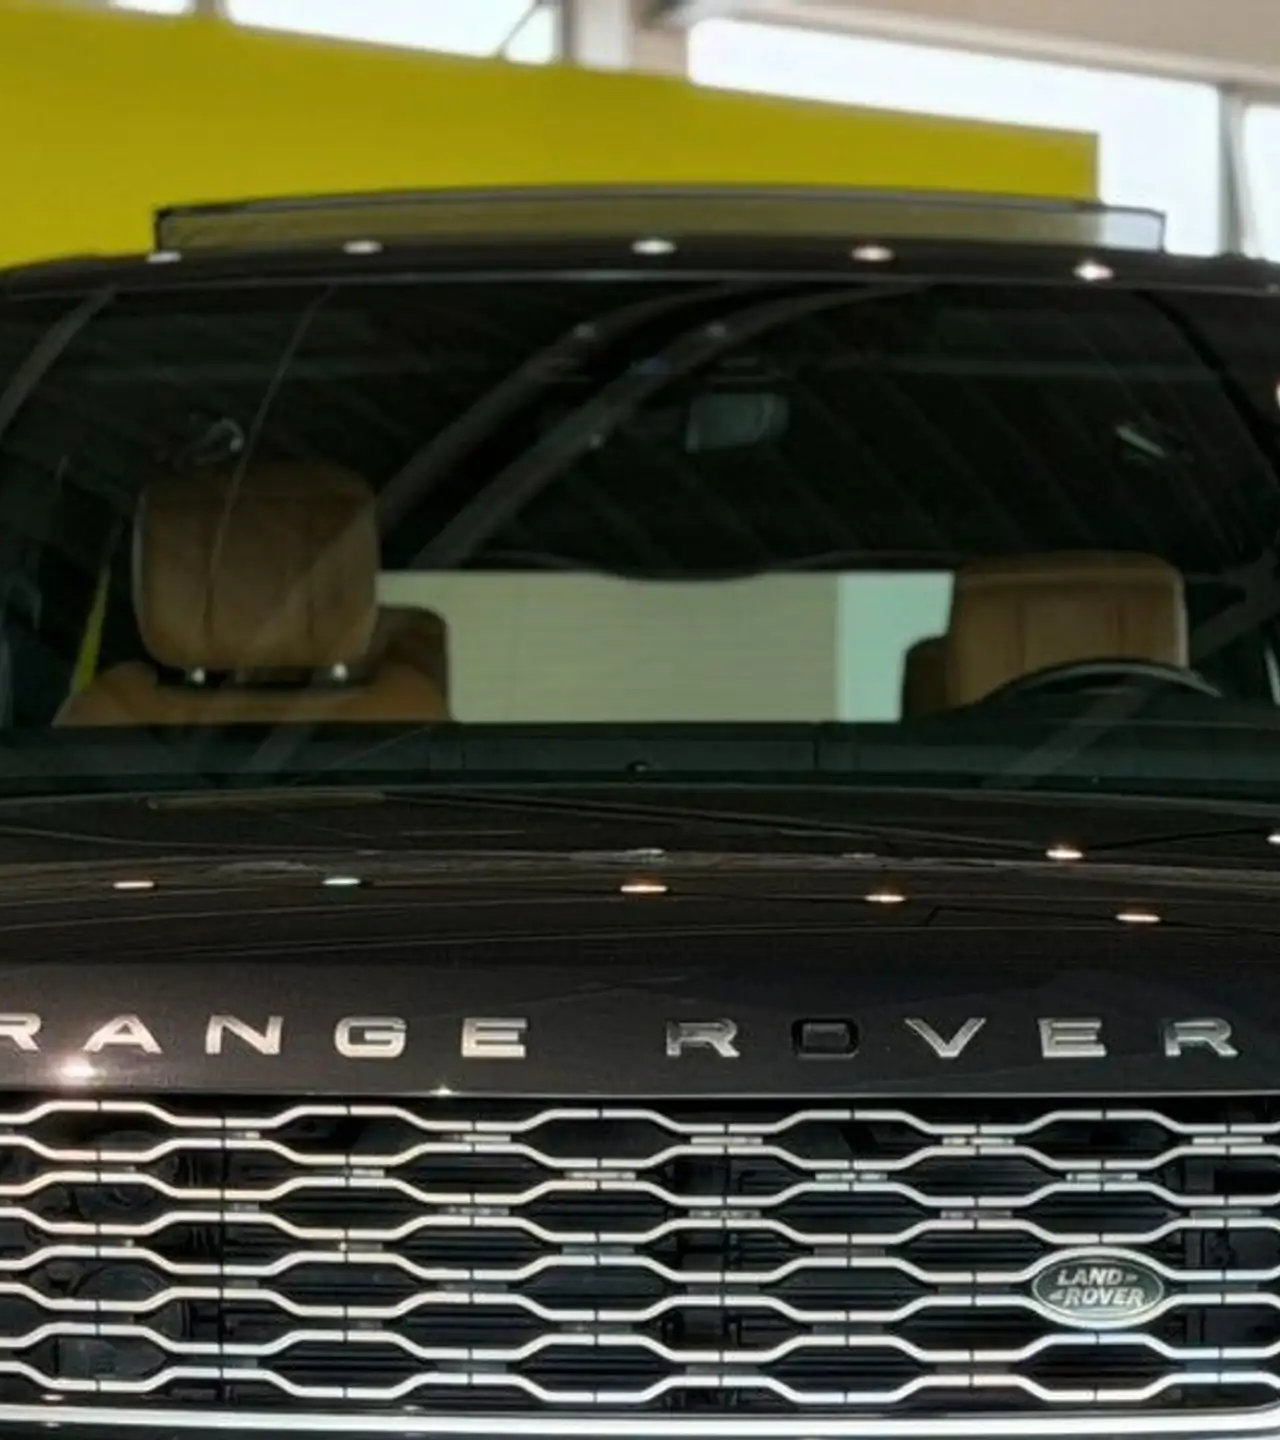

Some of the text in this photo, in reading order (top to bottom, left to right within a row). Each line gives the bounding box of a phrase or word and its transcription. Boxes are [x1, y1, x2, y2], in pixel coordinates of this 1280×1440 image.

[665, 1017, 1238, 1058] ROVER
[1056, 1267, 1123, 1286] LAND
[1063, 1286, 1146, 1307] ROVER
